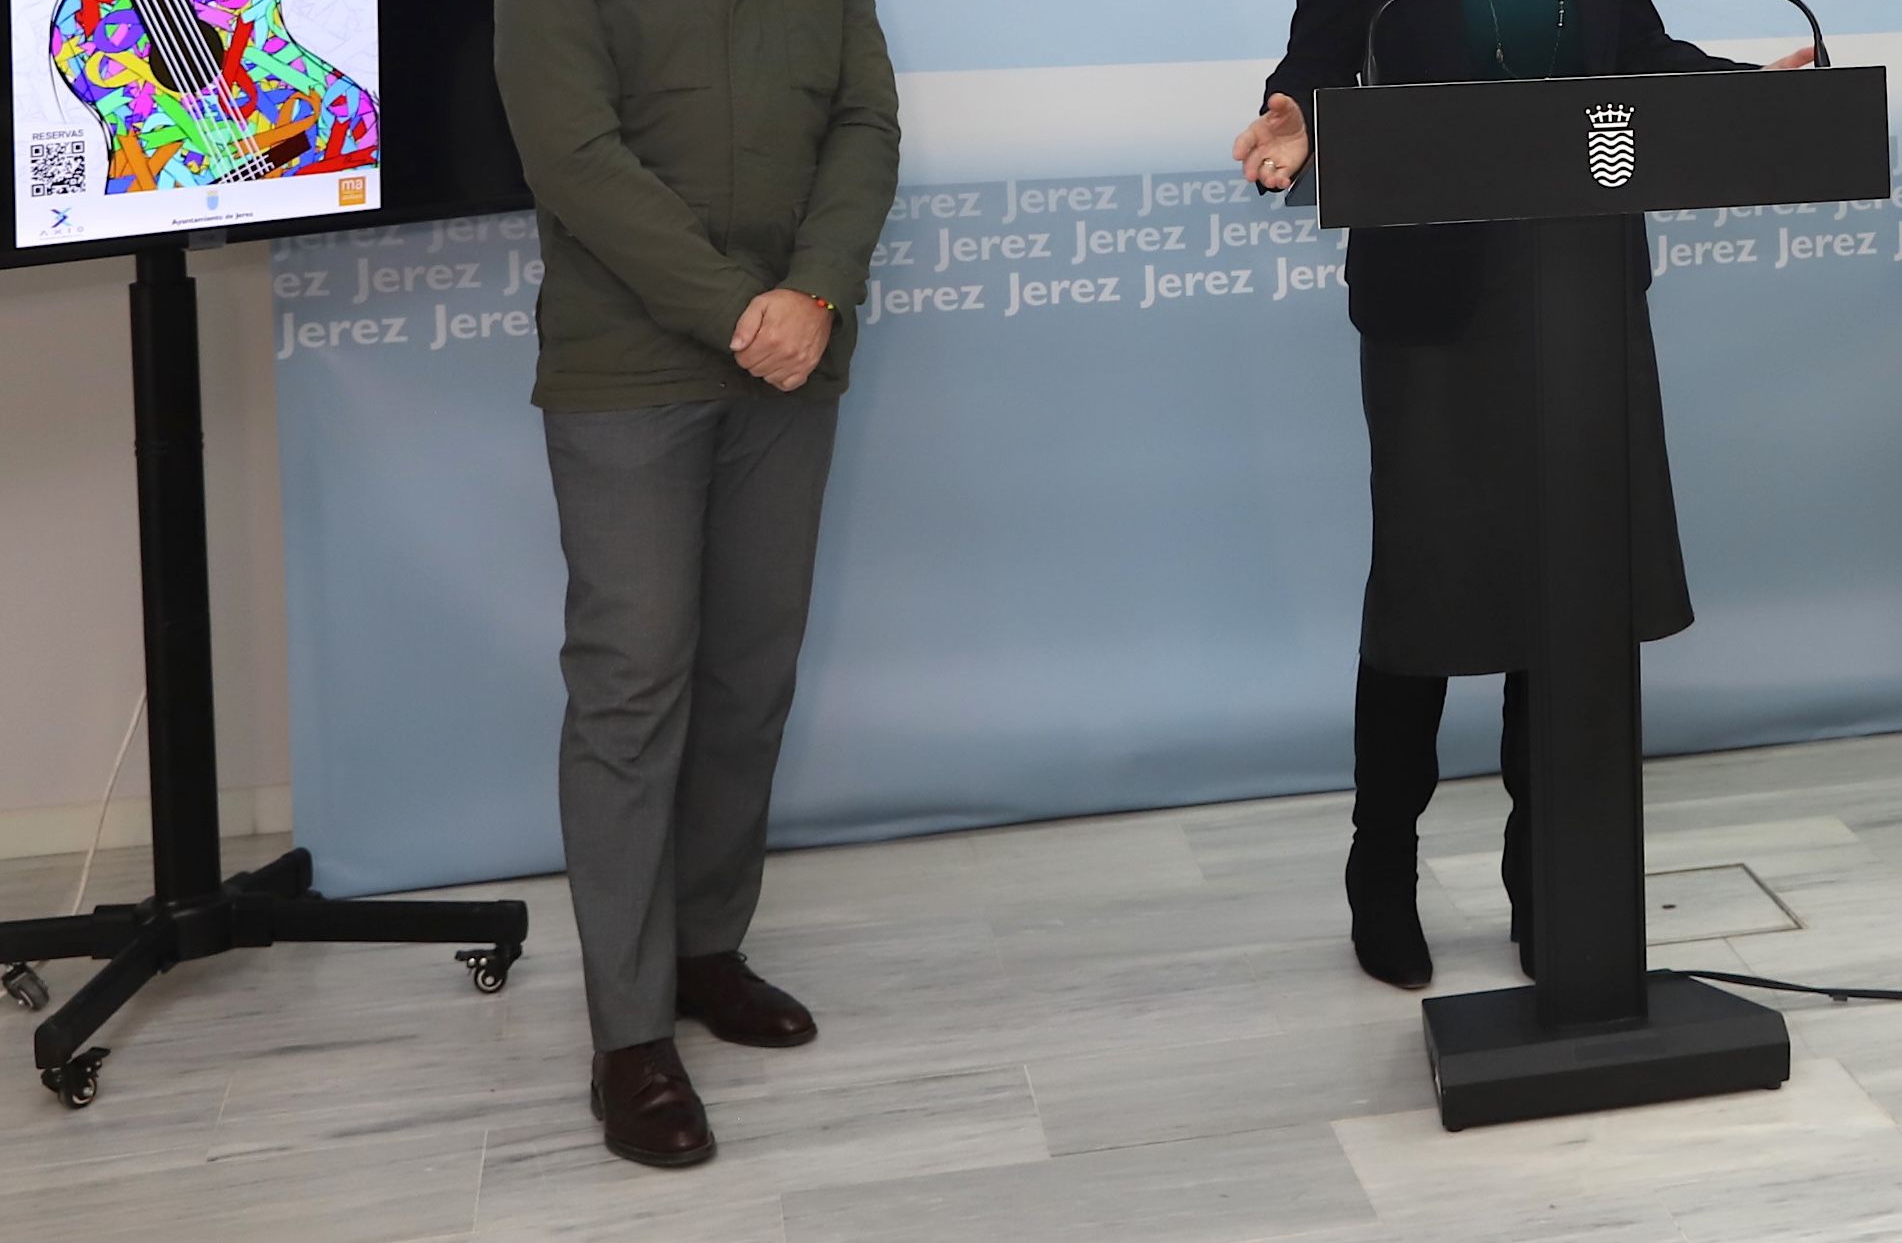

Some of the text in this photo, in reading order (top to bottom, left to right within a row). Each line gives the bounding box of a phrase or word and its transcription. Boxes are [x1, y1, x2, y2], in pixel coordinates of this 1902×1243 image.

[32, 129, 84, 140] RESERVAS
[886, 192, 983, 221] erez
[1002, 178, 1118, 224] Jerez
[1137, 173, 1252, 217] Jerez
[934, 227, 1052, 272] Jerez
[1071, 220, 1186, 265] Jerez
[1205, 213, 1317, 257] Jerez
[1654, 235, 1757, 277] Jerez
[1775, 227, 1877, 269] Jerez
[352, 258, 482, 305] Jerez
[866, 280, 985, 325] Jerez
[1004, 272, 1121, 317] Jerez
[1140, 264, 1254, 308] Jerez
[277, 303, 538, 360] Jerez Jere
